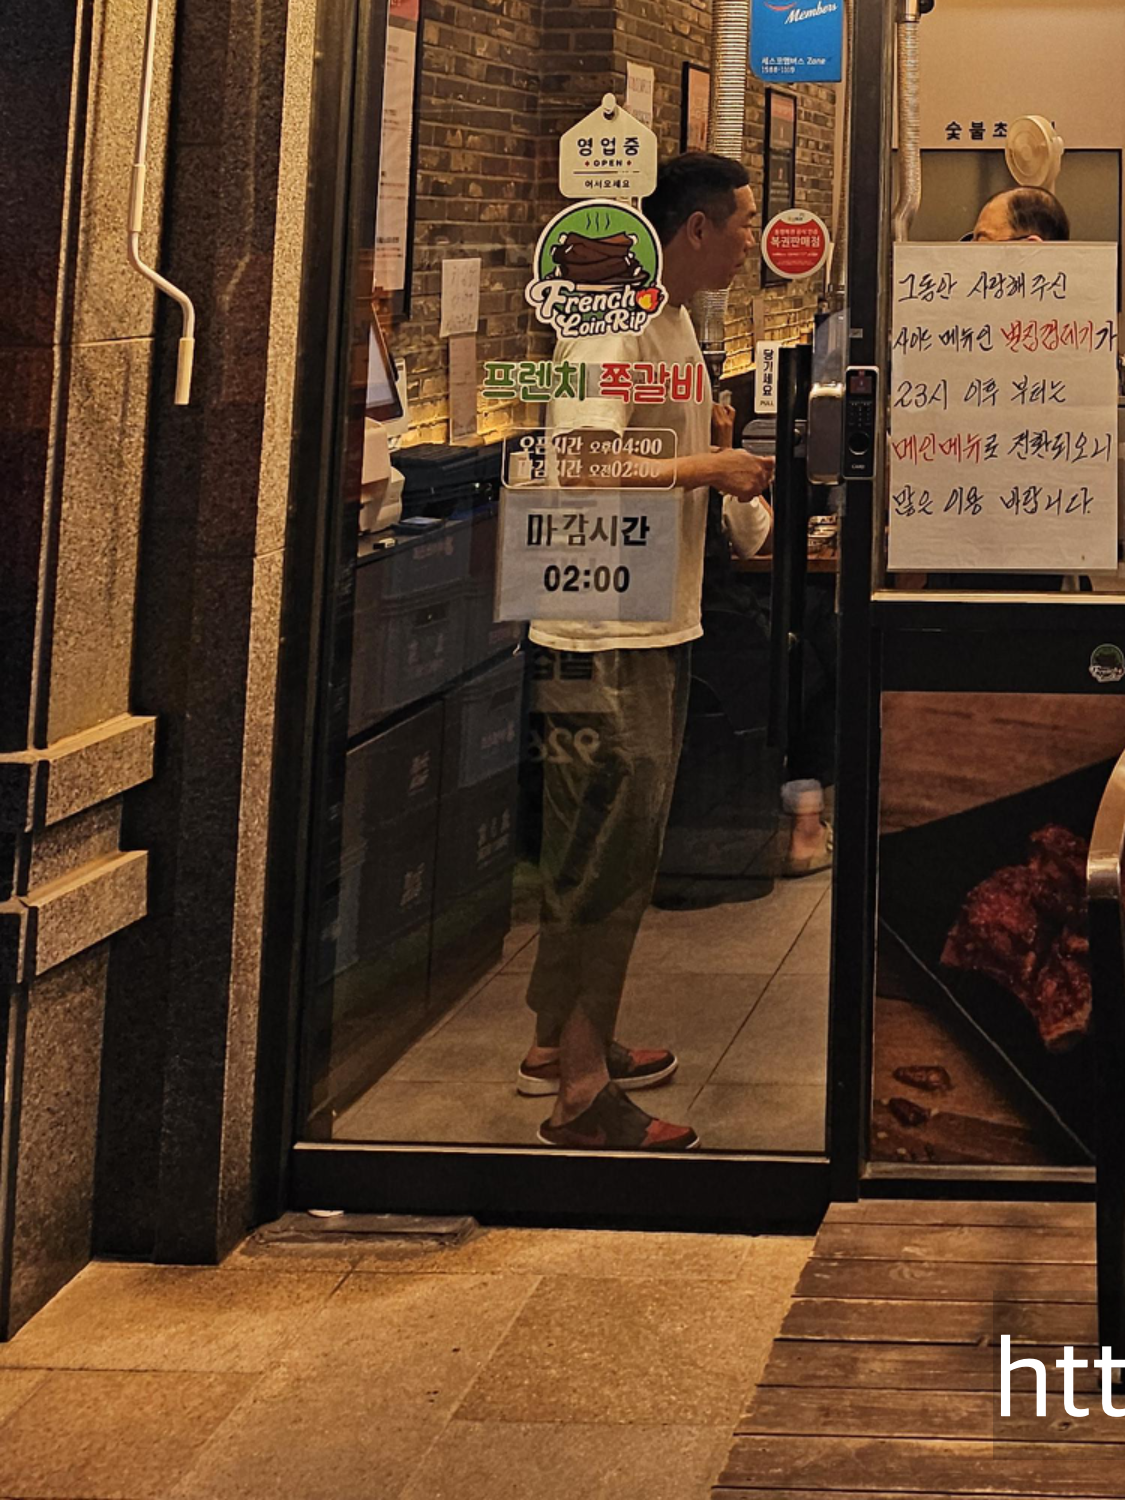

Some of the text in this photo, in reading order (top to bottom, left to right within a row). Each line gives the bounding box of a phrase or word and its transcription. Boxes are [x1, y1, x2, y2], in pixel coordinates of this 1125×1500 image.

[577, 136, 640, 157] 영업중
[531, 279, 636, 318] French
[898, 270, 1067, 303] 그동안 사랑해 주신
[556, 308, 647, 337] Loin Rip
[482, 360, 705, 404] 프렌치 쪽갈비
[762, 348, 775, 397] 당기세요
[894, 378, 948, 411] 23시
[963, 377, 1000, 408] 이후
[527, 513, 650, 548] 마감시간
[543, 564, 630, 594] 02:00
